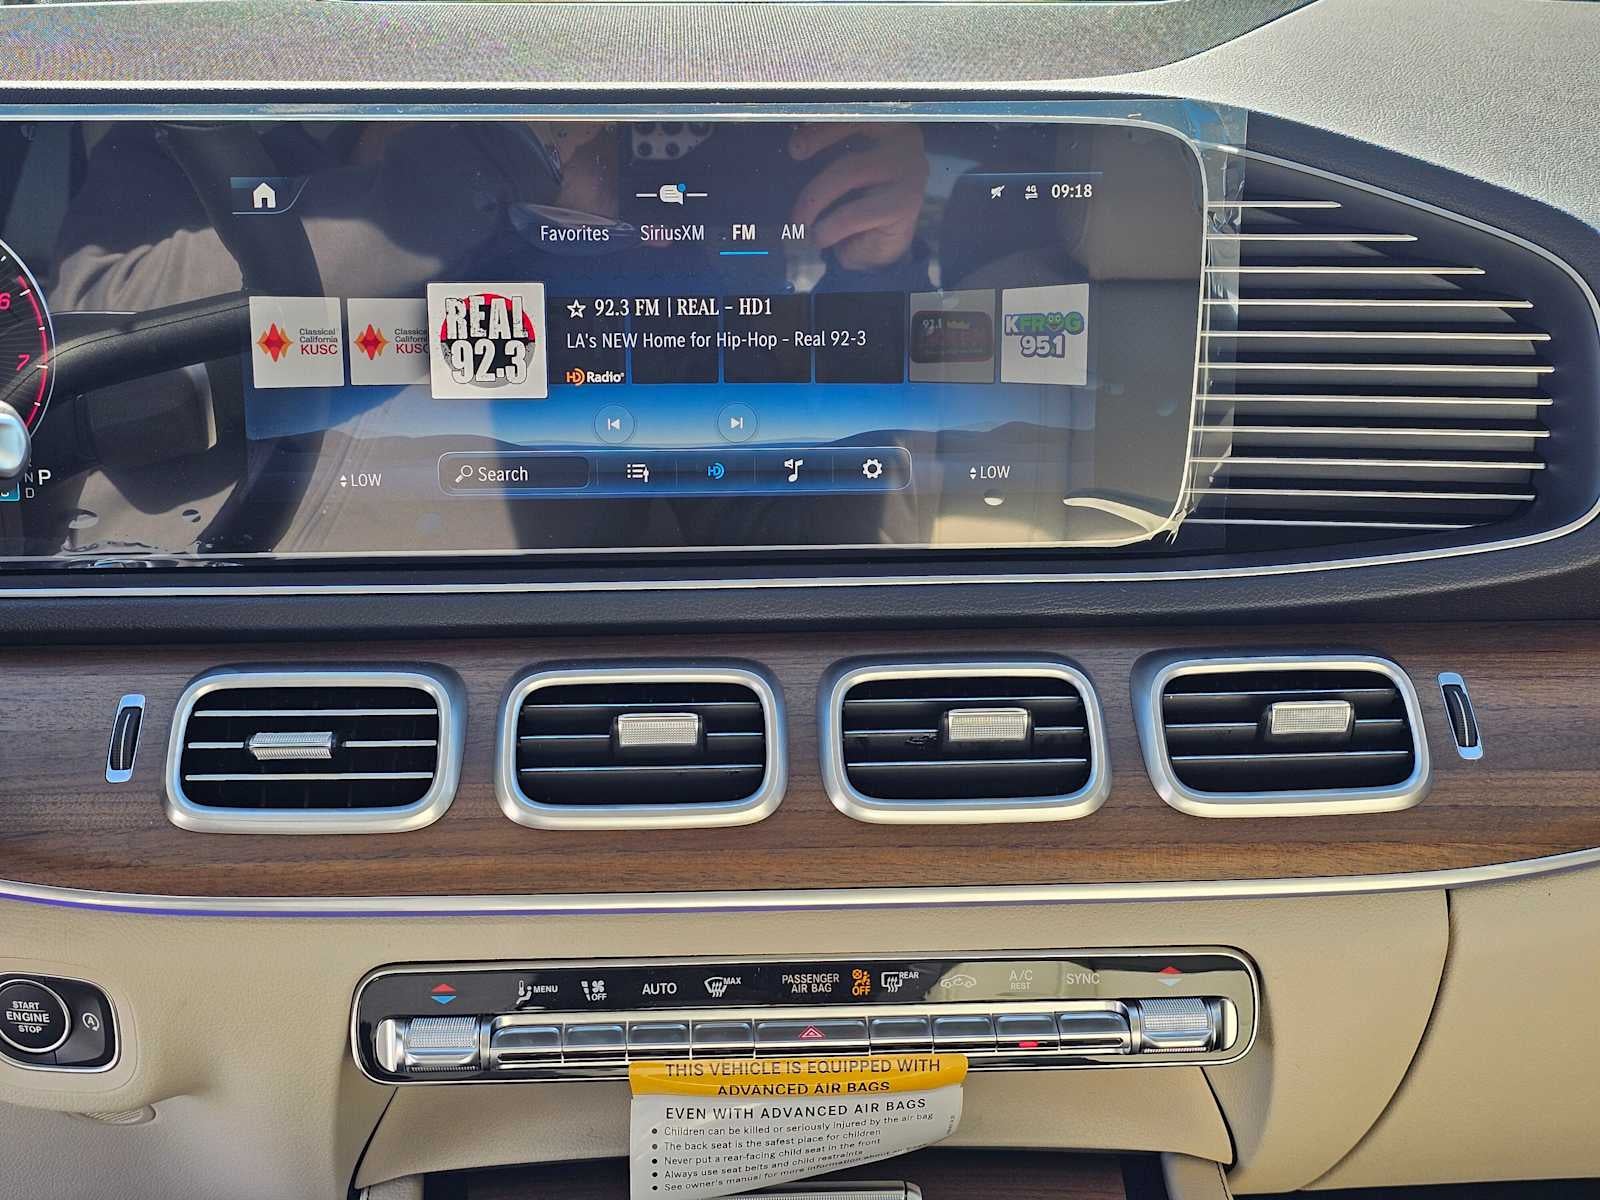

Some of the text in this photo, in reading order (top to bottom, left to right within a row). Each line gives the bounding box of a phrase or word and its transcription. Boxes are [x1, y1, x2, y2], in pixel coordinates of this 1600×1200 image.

[1025, 185, 1037, 193] 4G
[1051, 184, 1093, 198] 09:18
[541, 225, 609, 241] Favorites
[640, 224, 705, 241] SiriusXM
[732, 224, 755, 240] FM
[781, 223, 805, 239] AM
[594, 298, 630, 316] 92.3
[634, 299, 660, 316] FM
[677, 298, 720, 316] REAL
[739, 298, 772, 315] HD1
[444, 295, 529, 340] REAL
[299, 335, 338, 343] California
[567, 332, 597, 348] LA's
[602, 332, 638, 348] NEW
[643, 332, 685, 348] Home
[690, 331, 711, 347] for
[716, 331, 777, 350] Hip-Hop
[794, 331, 826, 346] Real
[830, 330, 867, 346] 92-3
[301, 344, 338, 355] KUSC
[16, 354, 30, 371] 7
[450, 338, 528, 384] 92.3
[24, 472, 33, 483] N
[38, 469, 51, 485] P
[478, 466, 529, 482] Search
[980, 465, 1010, 479] LOW
[350, 473, 382, 487] LOW
[25, 487, 35, 498] D
[723, 976, 742, 985] MAX
[781, 973, 840, 985] PASSENGER
[899, 971, 919, 979] REAR
[1009, 969, 1033, 981] A/C
[1066, 973, 1100, 985] SYNC
[533, 985, 558, 993] MENU
[642, 982, 677, 995] AUTO
[791, 983, 832, 993] AIR BAG
[852, 986, 871, 996] OFF
[1010, 982, 1031, 990] REST
[592, 993, 607, 1001] OFF
[12, 1000, 39, 1010] START
[5, 1011, 50, 1023] ENGINE
[18, 1024, 42, 1034] STOP
[665, 1059, 940, 1077] THIS VEHICLE IS EQUIPPED WITH
[718, 1081, 890, 1096] ADVANCED AIR BAGS
[666, 1098, 926, 1119] EVEN WITH ADVANCED AIR BAGS
[664, 1126, 705, 1136] Children
[728, 1126, 741, 1135] be
[744, 1125, 770, 1134] killed
[786, 1120, 830, 1132] seriously
[833, 1119, 867, 1129] injured
[870, 1118, 881, 1127] by
[883, 1117, 899, 1125] the
[664, 1142, 681, 1151] The
[684, 1141, 708, 1150] back
[711, 1141, 731, 1149] seat
[735, 1140, 743, 1148] is
[746, 1139, 762, 1147] the
[765, 1137, 794, 1146] safest
[797, 1136, 824, 1145] place
[842, 1129, 881, 1139] children
[664, 1157, 692, 1165] Never
[695, 1156, 711, 1165] put
[723, 1151, 776, 1163] rear-facing
[778, 1146, 801, 1157] child
[805, 1146, 825, 1154] seat
[828, 1143, 837, 1152] in
[840, 1141, 855, 1149] the
[858, 1138, 881, 1147] front
[664, 1170, 698, 1180] Always
[721, 1166, 741, 1174] seat
[745, 1163, 768, 1172] belts
[771, 1160, 789, 1168] and
[792, 1157, 815, 1166] child
[664, 1183, 682, 1191] See
[685, 1179, 723, 1189] owner's
[726, 1175, 761, 1184] manual
